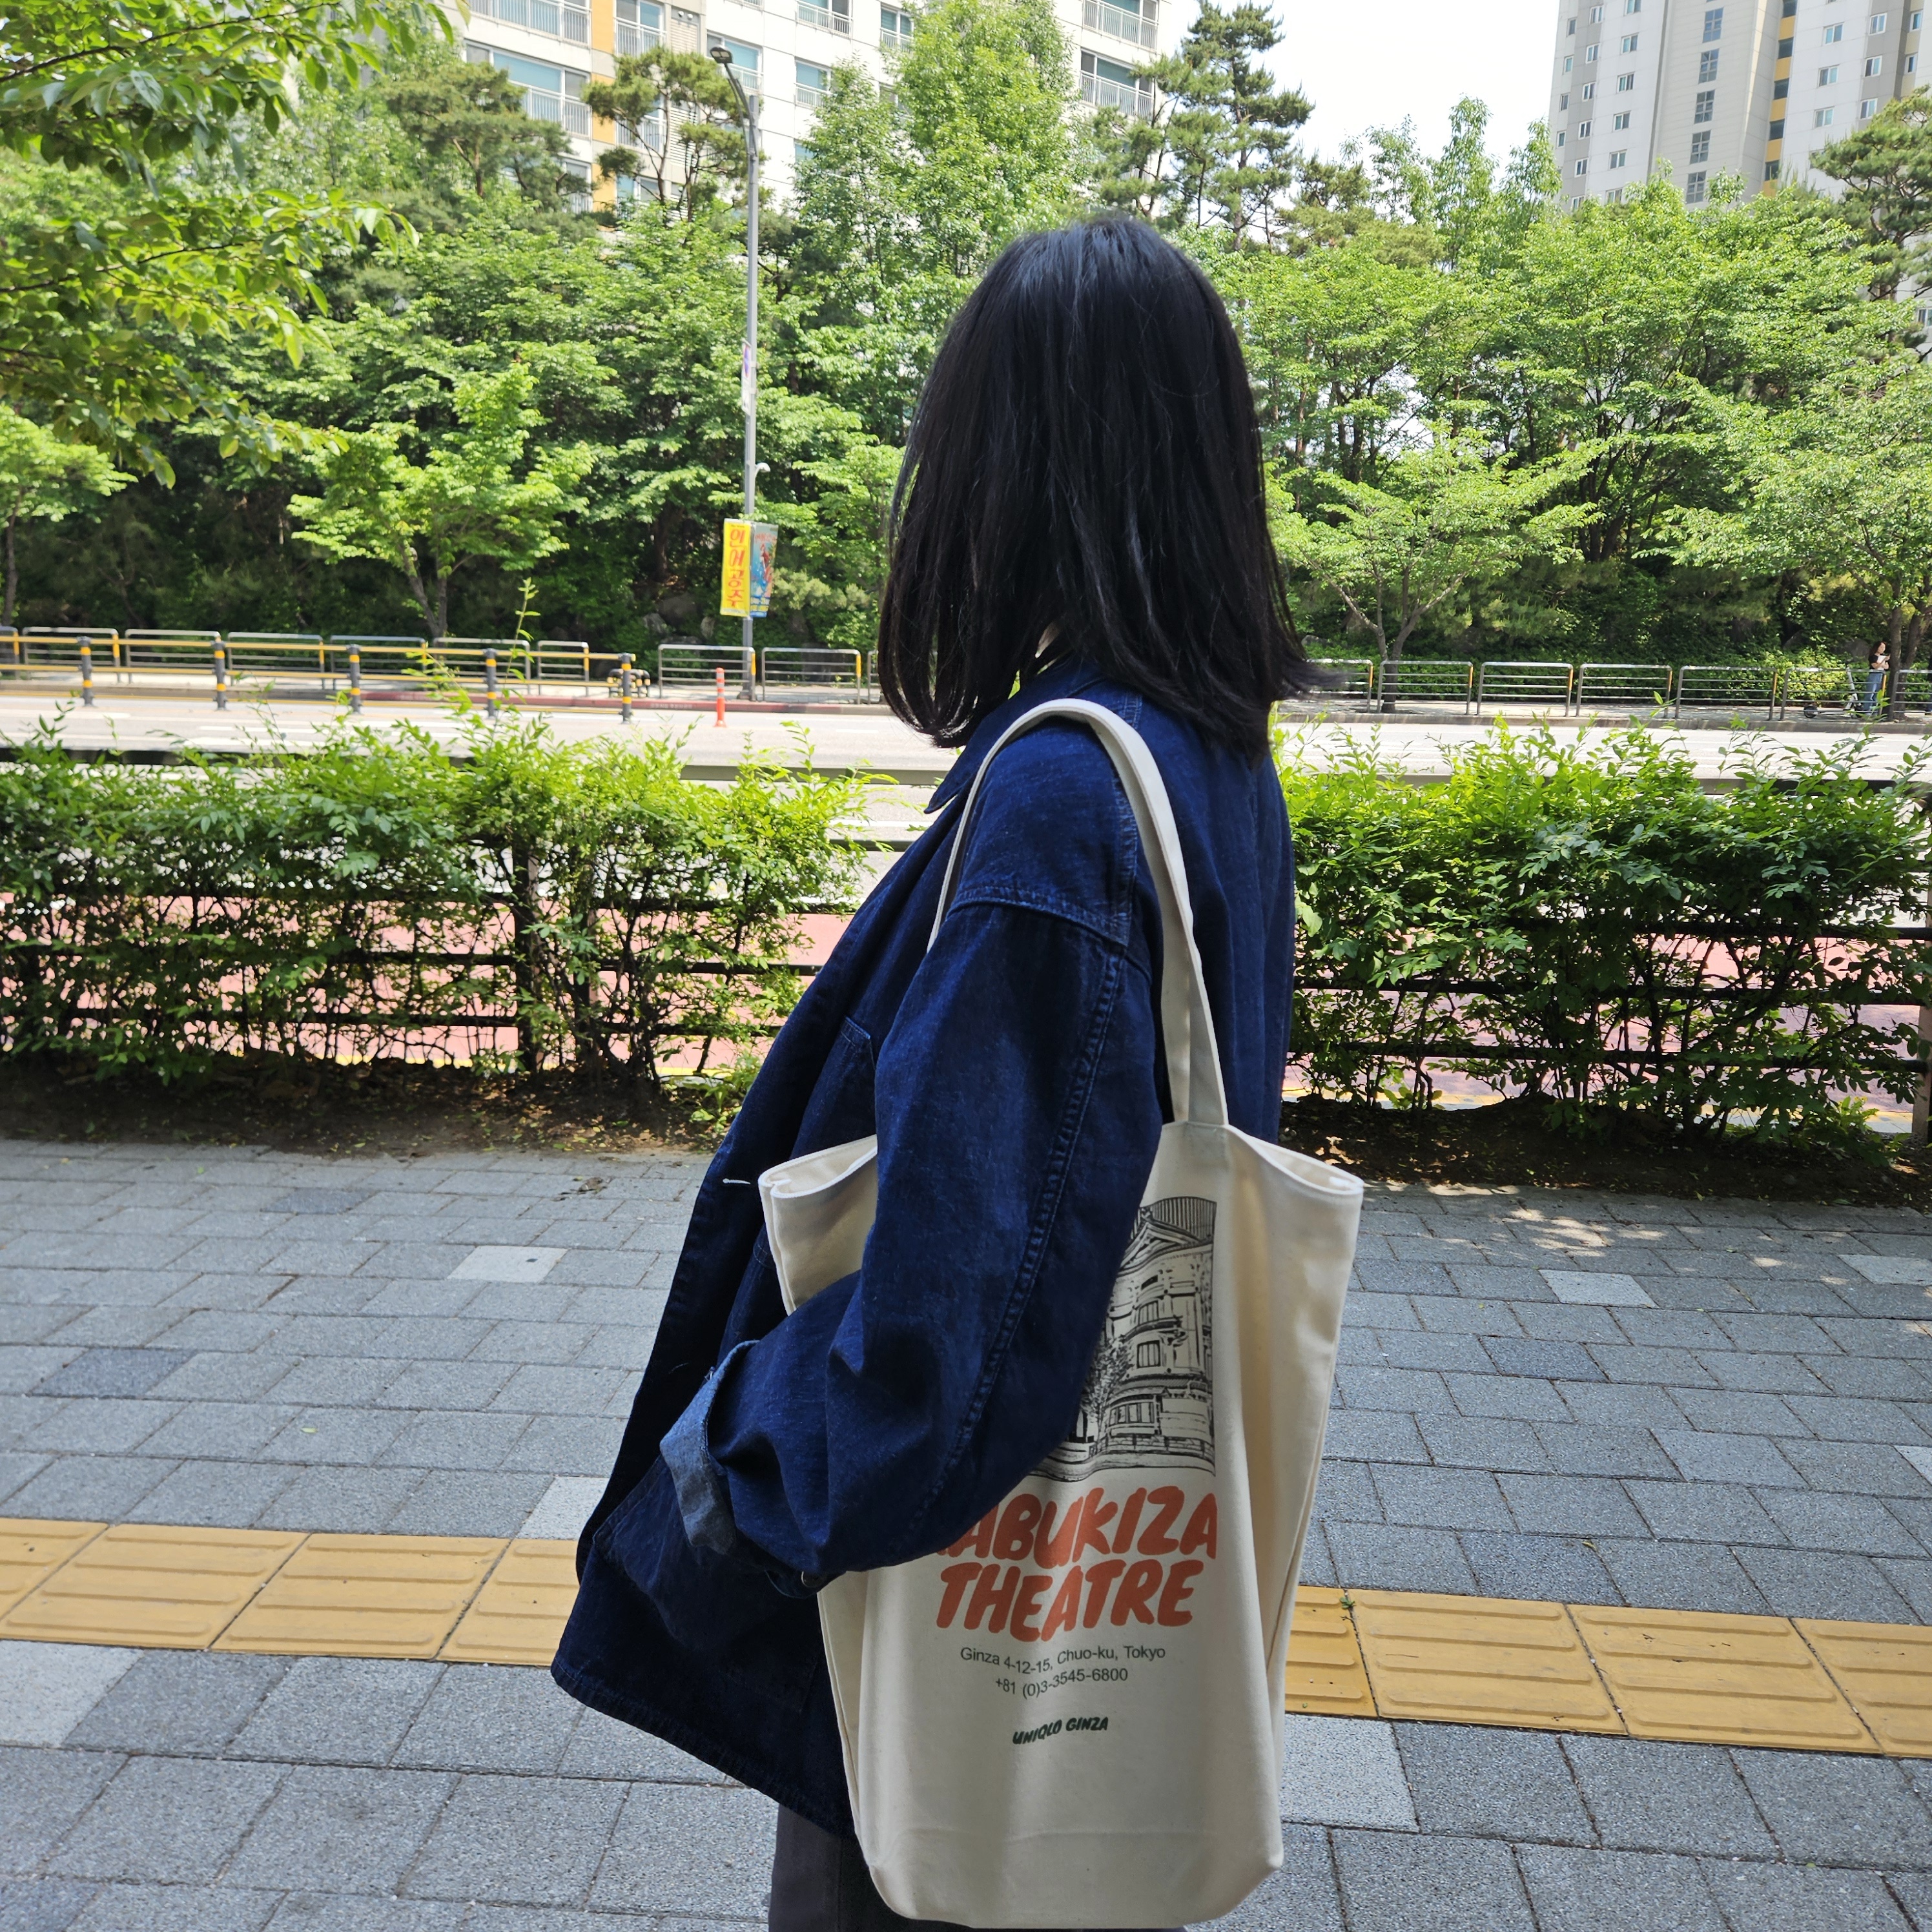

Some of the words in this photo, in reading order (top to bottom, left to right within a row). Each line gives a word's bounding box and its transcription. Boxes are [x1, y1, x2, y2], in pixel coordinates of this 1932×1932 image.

[726, 528, 746, 607] 인어공주
[936, 1485, 1218, 1569] ABUKIZA
[936, 1558, 1204, 1642] THEATRE
[960, 1647, 1000, 1665] Ginza
[1003, 1656, 1053, 1674] 4-12-15,
[1057, 1645, 1118, 1665] Chuo-ku,
[1123, 1645, 1166, 1662] Tokyo
[995, 1678, 1016, 1695] +81
[1022, 1667, 1129, 1700] (0)3-3545-6800
[1012, 1718, 1063, 1745] UNIQLO
[1065, 1716, 1109, 1732] GINZA
